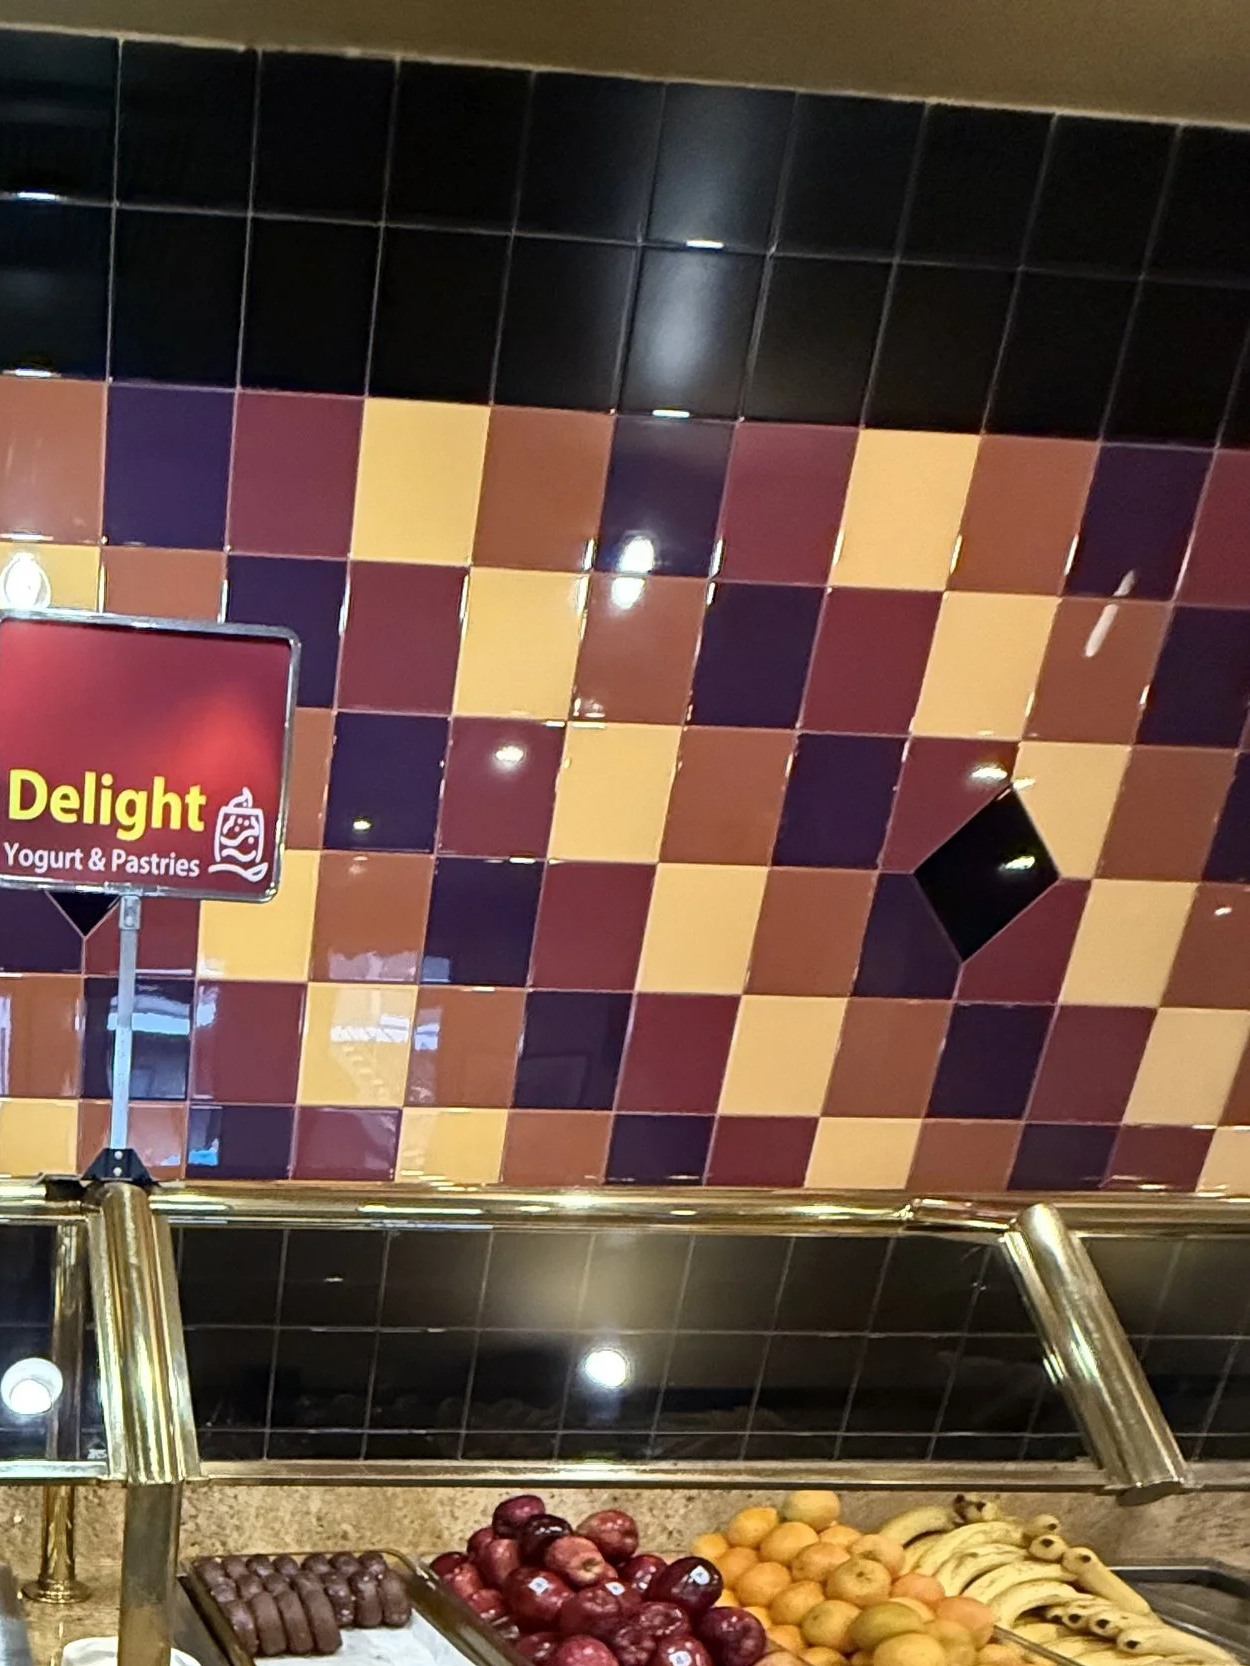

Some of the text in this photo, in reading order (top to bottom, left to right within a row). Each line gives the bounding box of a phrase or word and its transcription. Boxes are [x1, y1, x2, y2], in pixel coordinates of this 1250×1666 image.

[8, 768, 207, 841] Delight
[3, 842, 200, 877] Yogurt & Pastries
